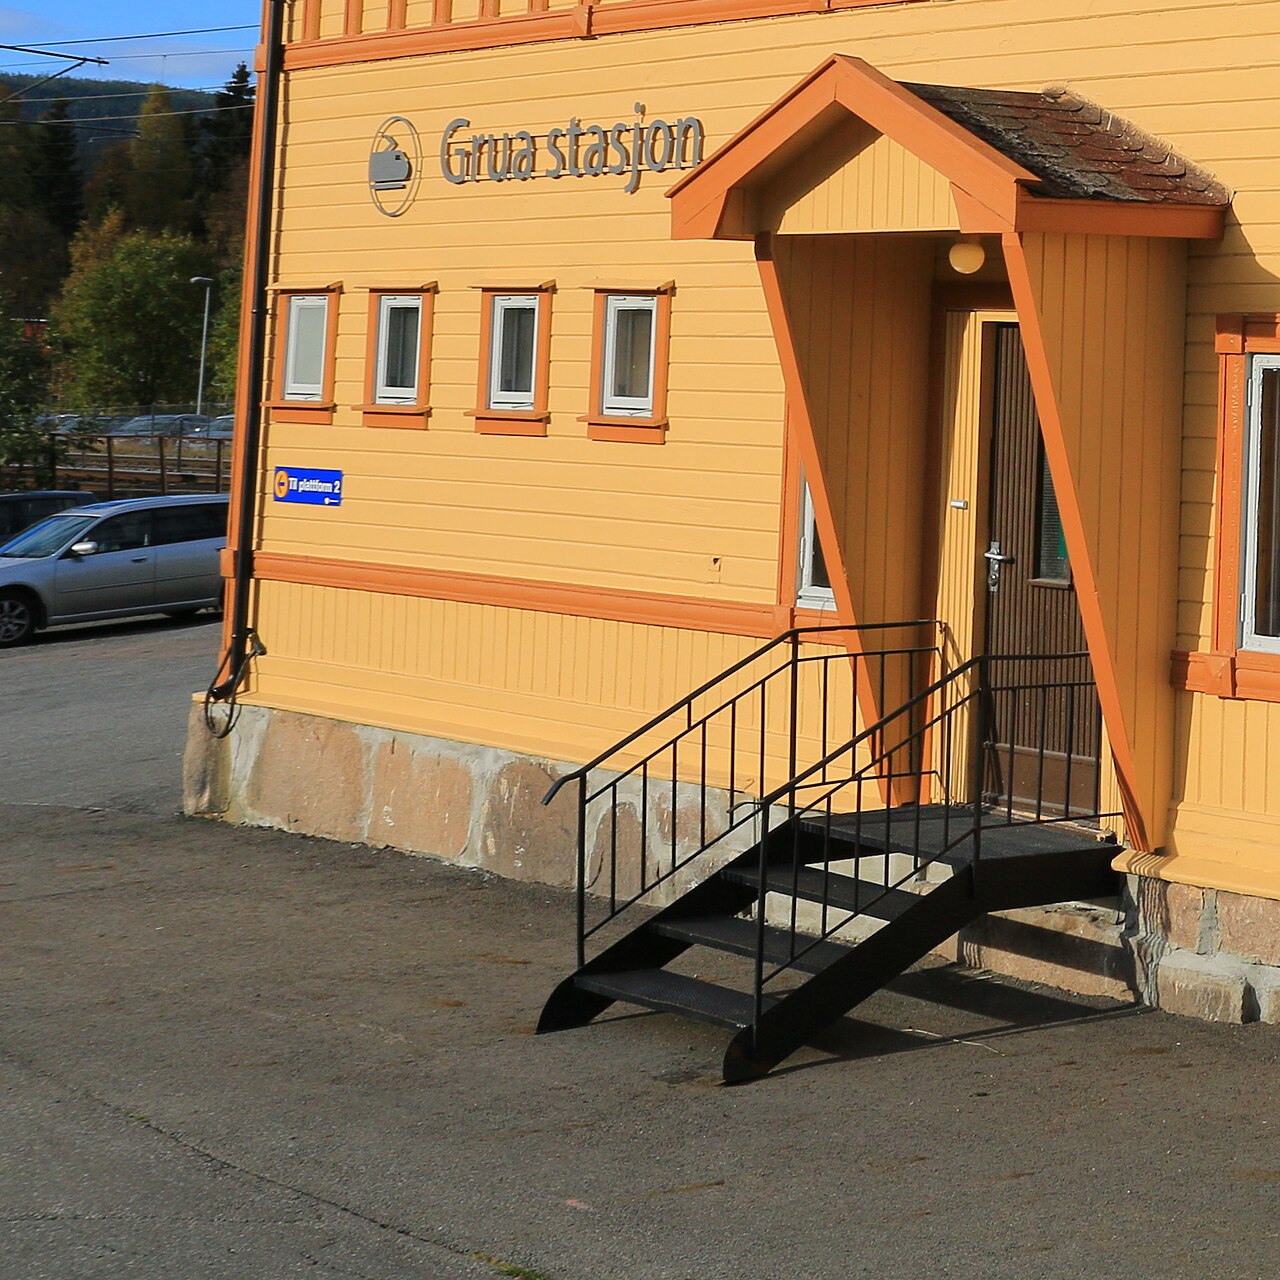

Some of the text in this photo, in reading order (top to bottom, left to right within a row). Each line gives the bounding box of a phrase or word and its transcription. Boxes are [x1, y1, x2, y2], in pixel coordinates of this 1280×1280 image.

[440, 102, 704, 194] Grua stasjon
[288, 477, 341, 494] Til plattform 2
